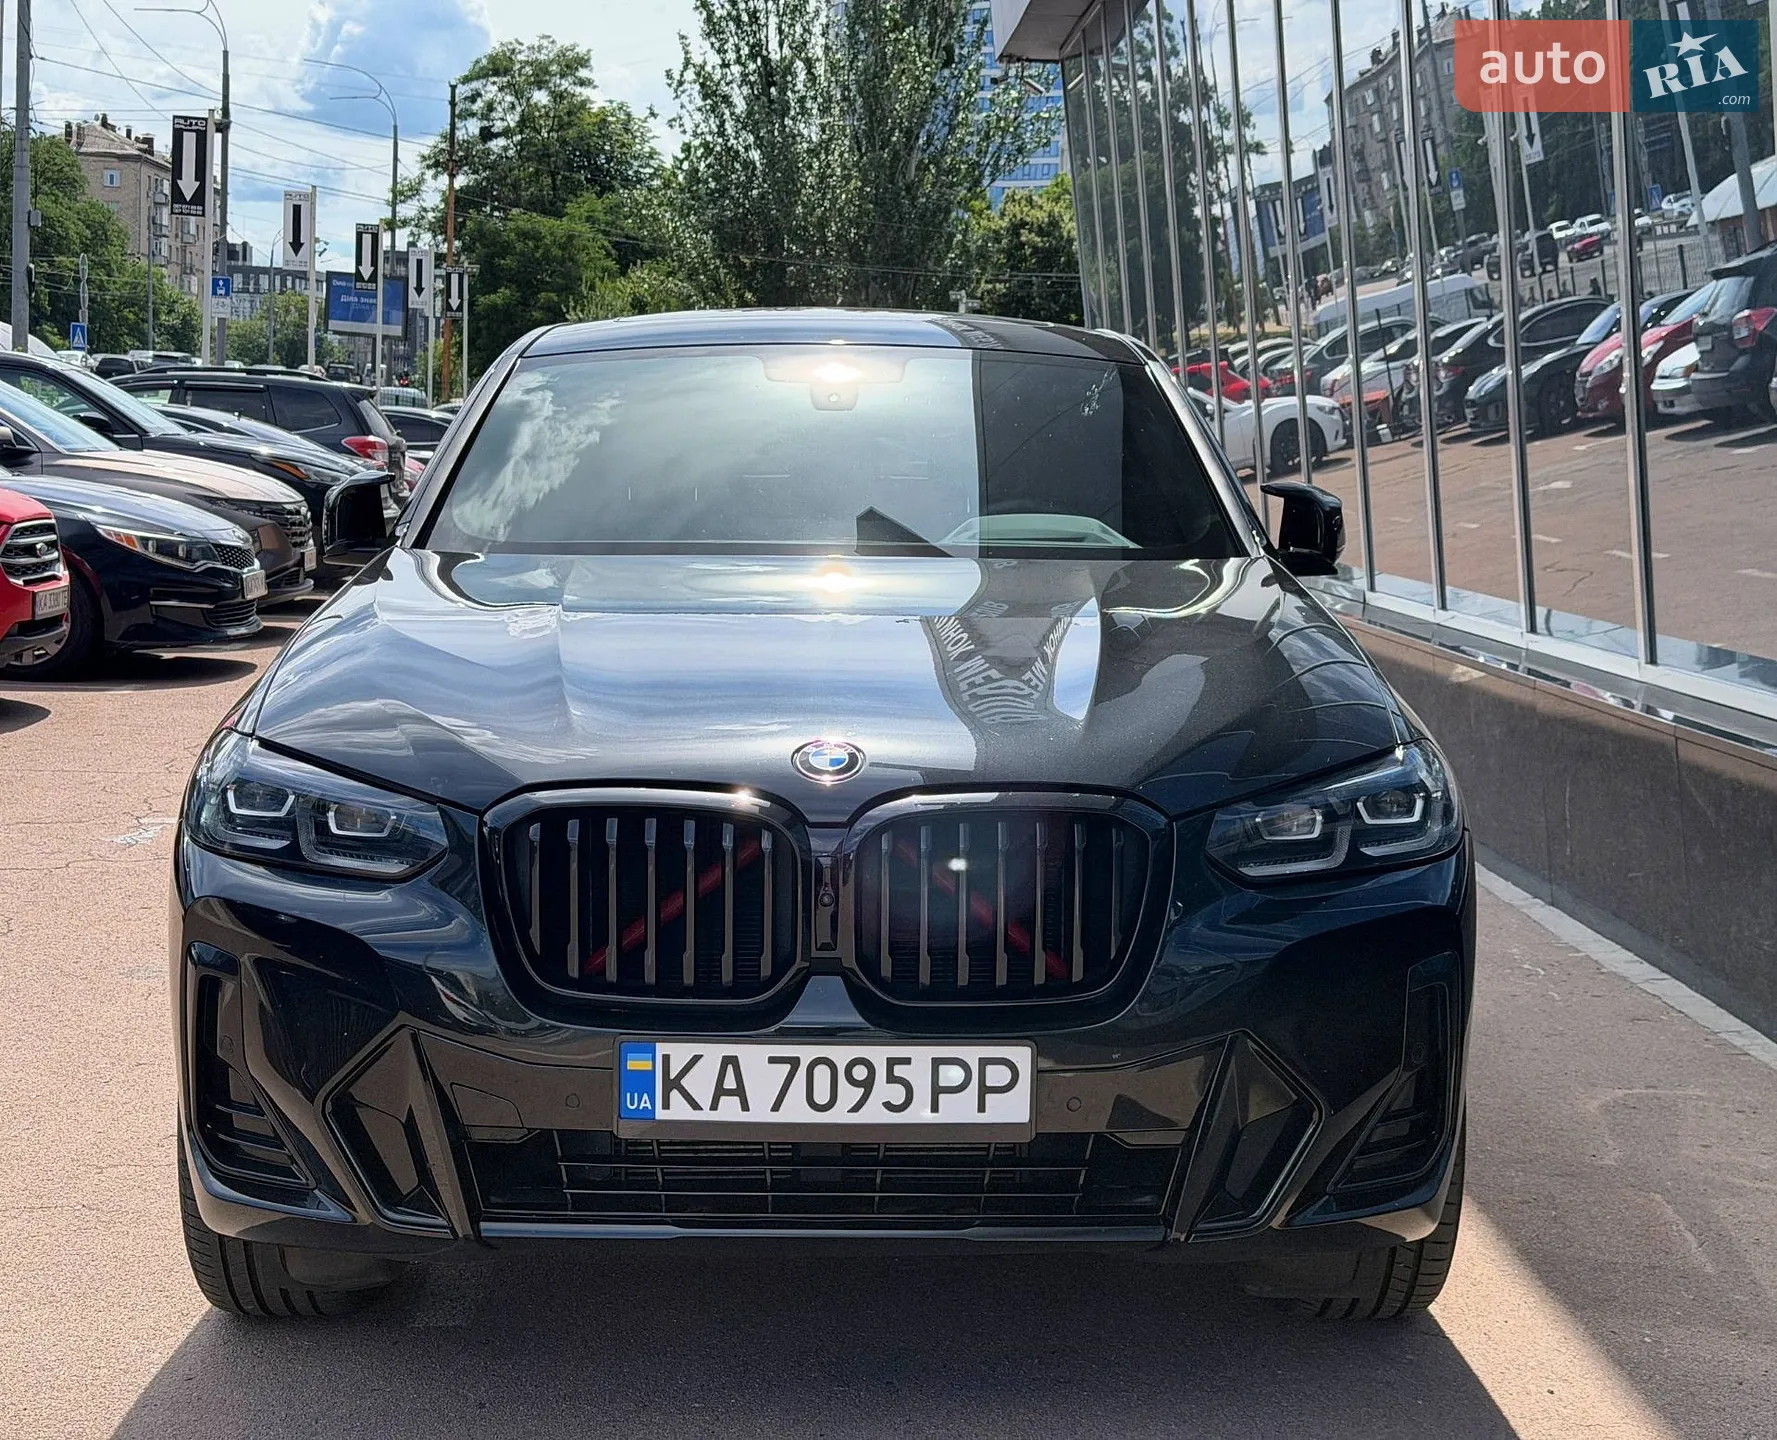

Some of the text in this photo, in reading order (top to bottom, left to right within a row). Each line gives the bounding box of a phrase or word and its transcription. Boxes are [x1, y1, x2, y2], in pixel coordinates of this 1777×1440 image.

[174, 118, 206, 126] AUTO
[661, 1053, 1020, 1114] KA 7095 PP
[626, 1092, 652, 1110] UA
